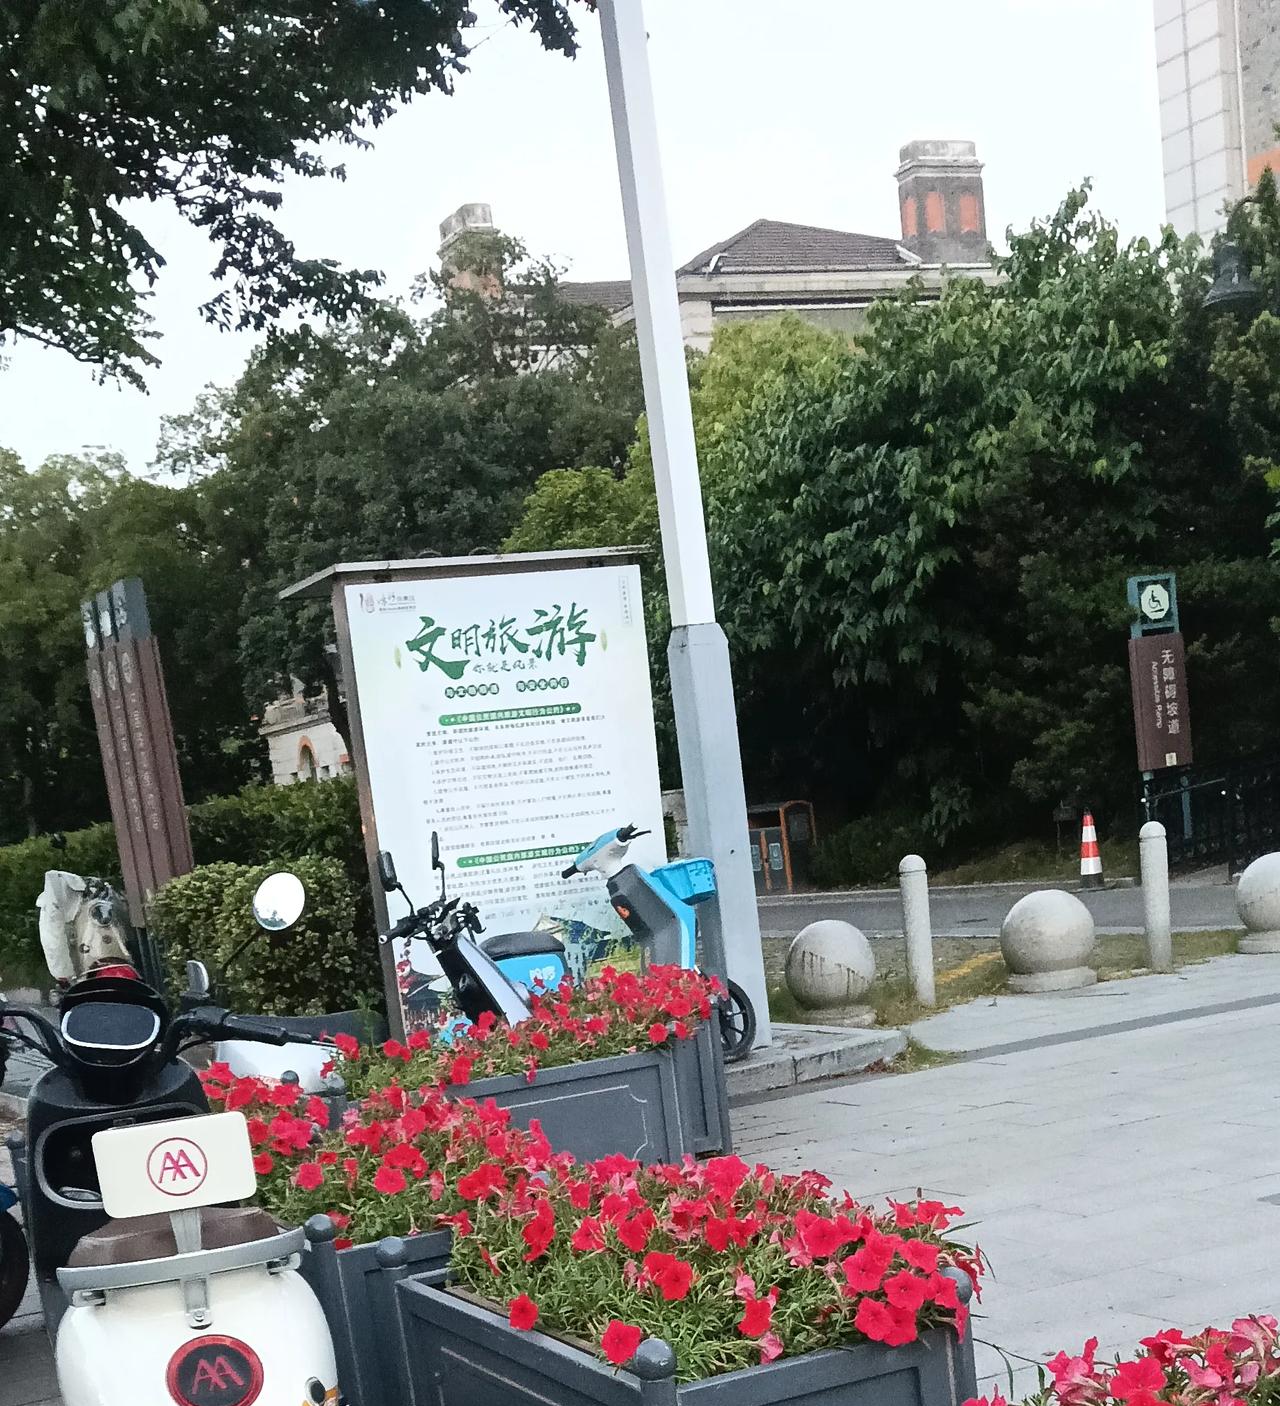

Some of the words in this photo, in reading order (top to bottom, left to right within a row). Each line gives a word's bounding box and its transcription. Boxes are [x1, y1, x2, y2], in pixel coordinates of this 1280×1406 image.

[406, 602, 597, 679] 文明旅游
[1161, 649, 1180, 735] 无障碍坡道
